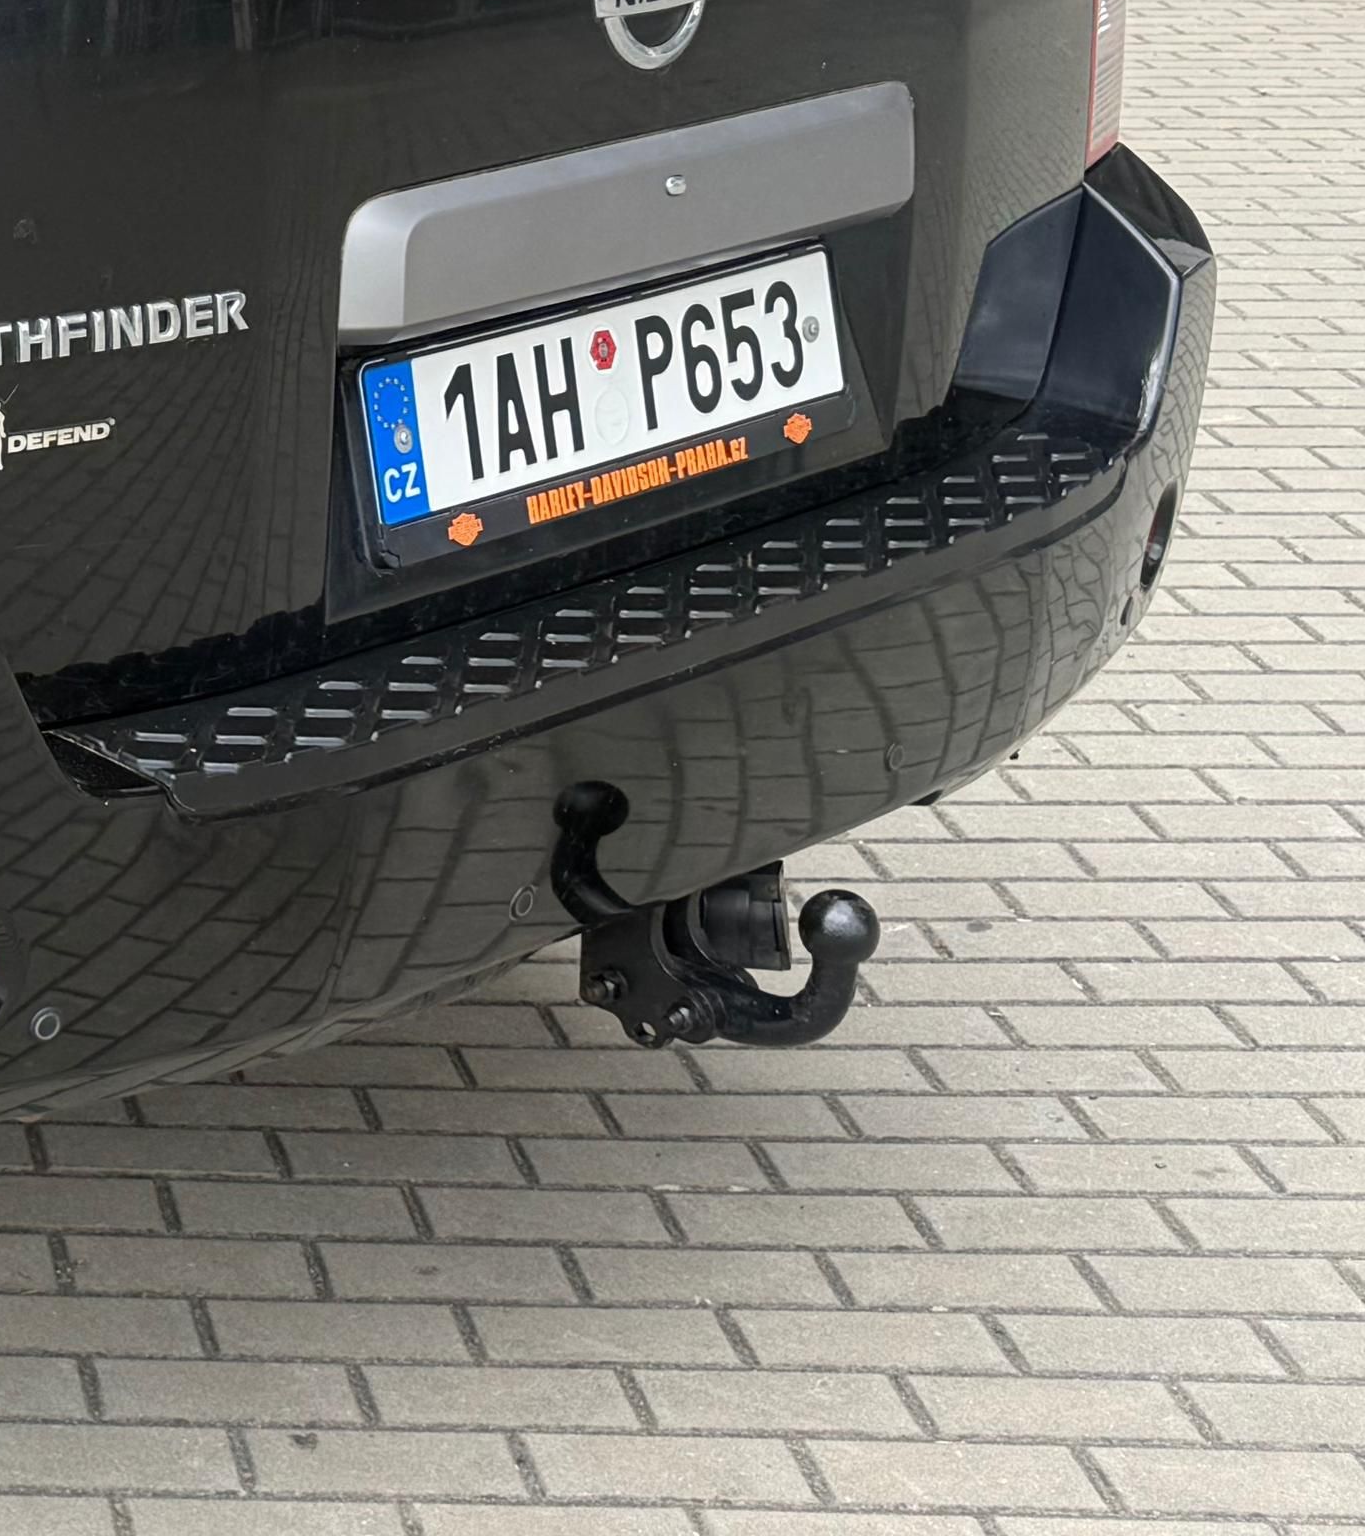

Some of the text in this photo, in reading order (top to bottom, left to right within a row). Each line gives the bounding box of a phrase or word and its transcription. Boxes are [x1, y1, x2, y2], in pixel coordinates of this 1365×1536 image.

[443, 280, 805, 481] 1AH P653
[7, 421, 112, 454] DEFEND
[383, 462, 421, 505] CZ
